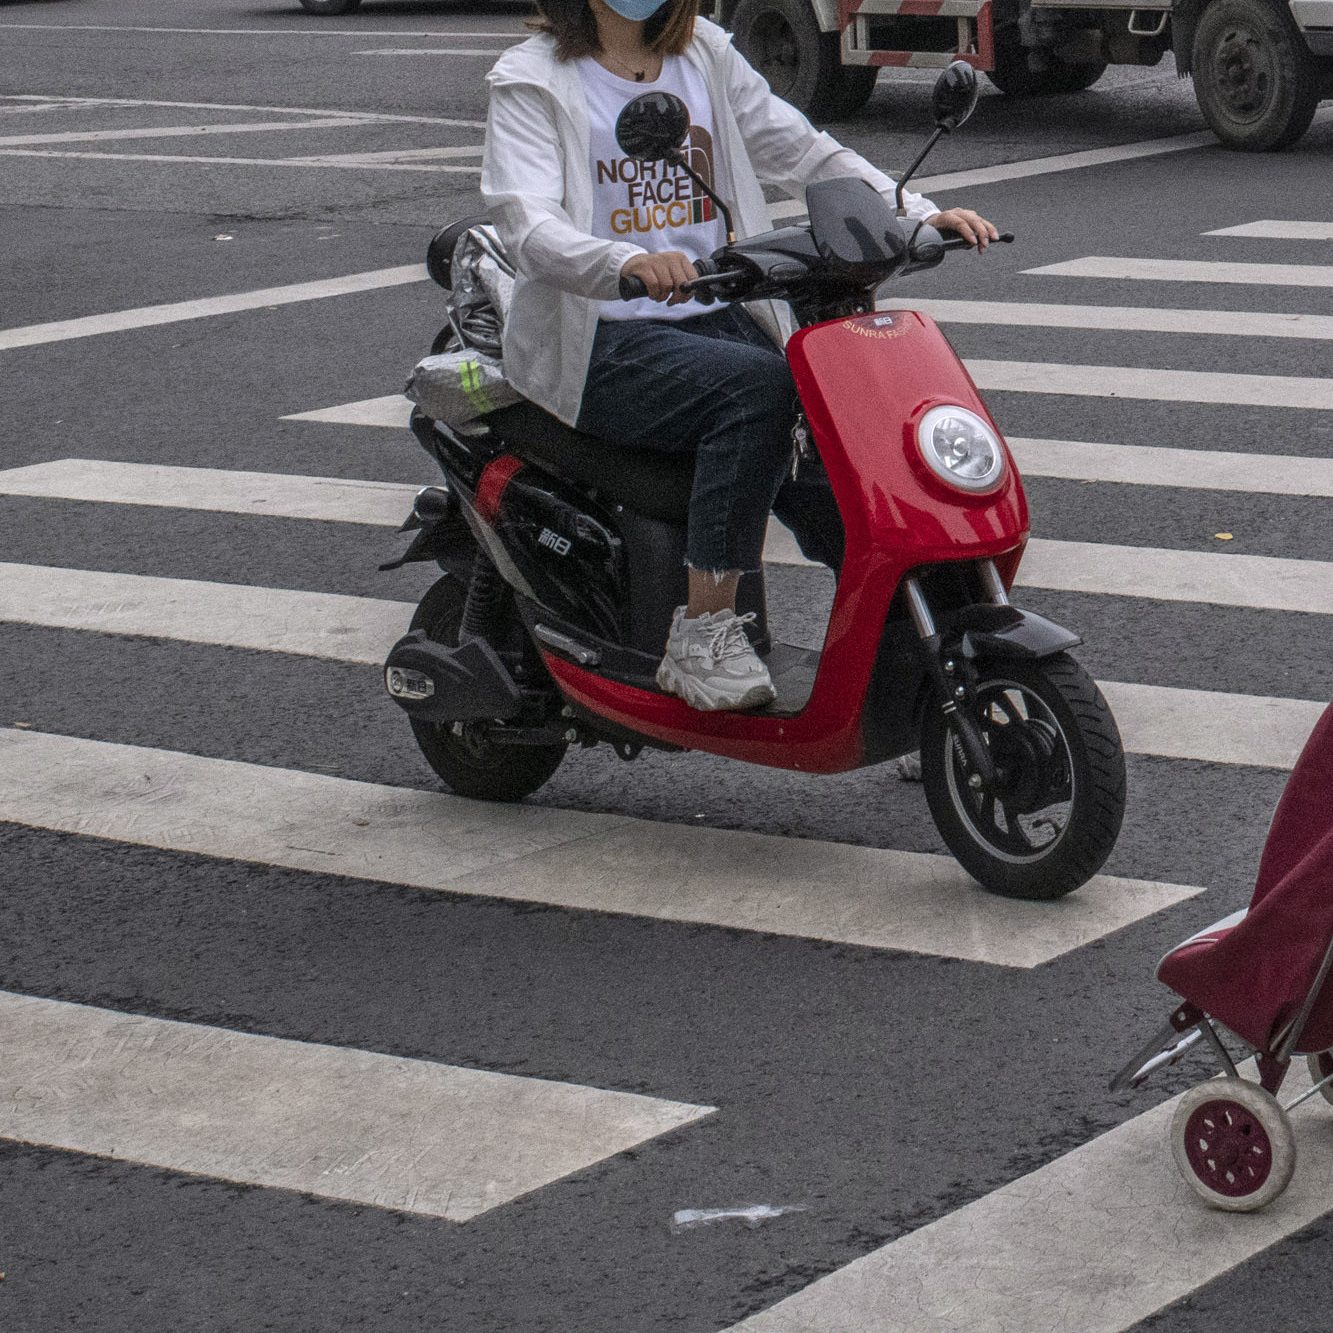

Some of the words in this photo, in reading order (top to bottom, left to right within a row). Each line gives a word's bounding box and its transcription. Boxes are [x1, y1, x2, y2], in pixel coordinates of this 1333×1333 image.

[628, 175, 691, 207] FACE
[610, 201, 692, 234] GUCCI
[842, 320, 887, 340] SUNRA
[538, 528, 571, 555] 新日
